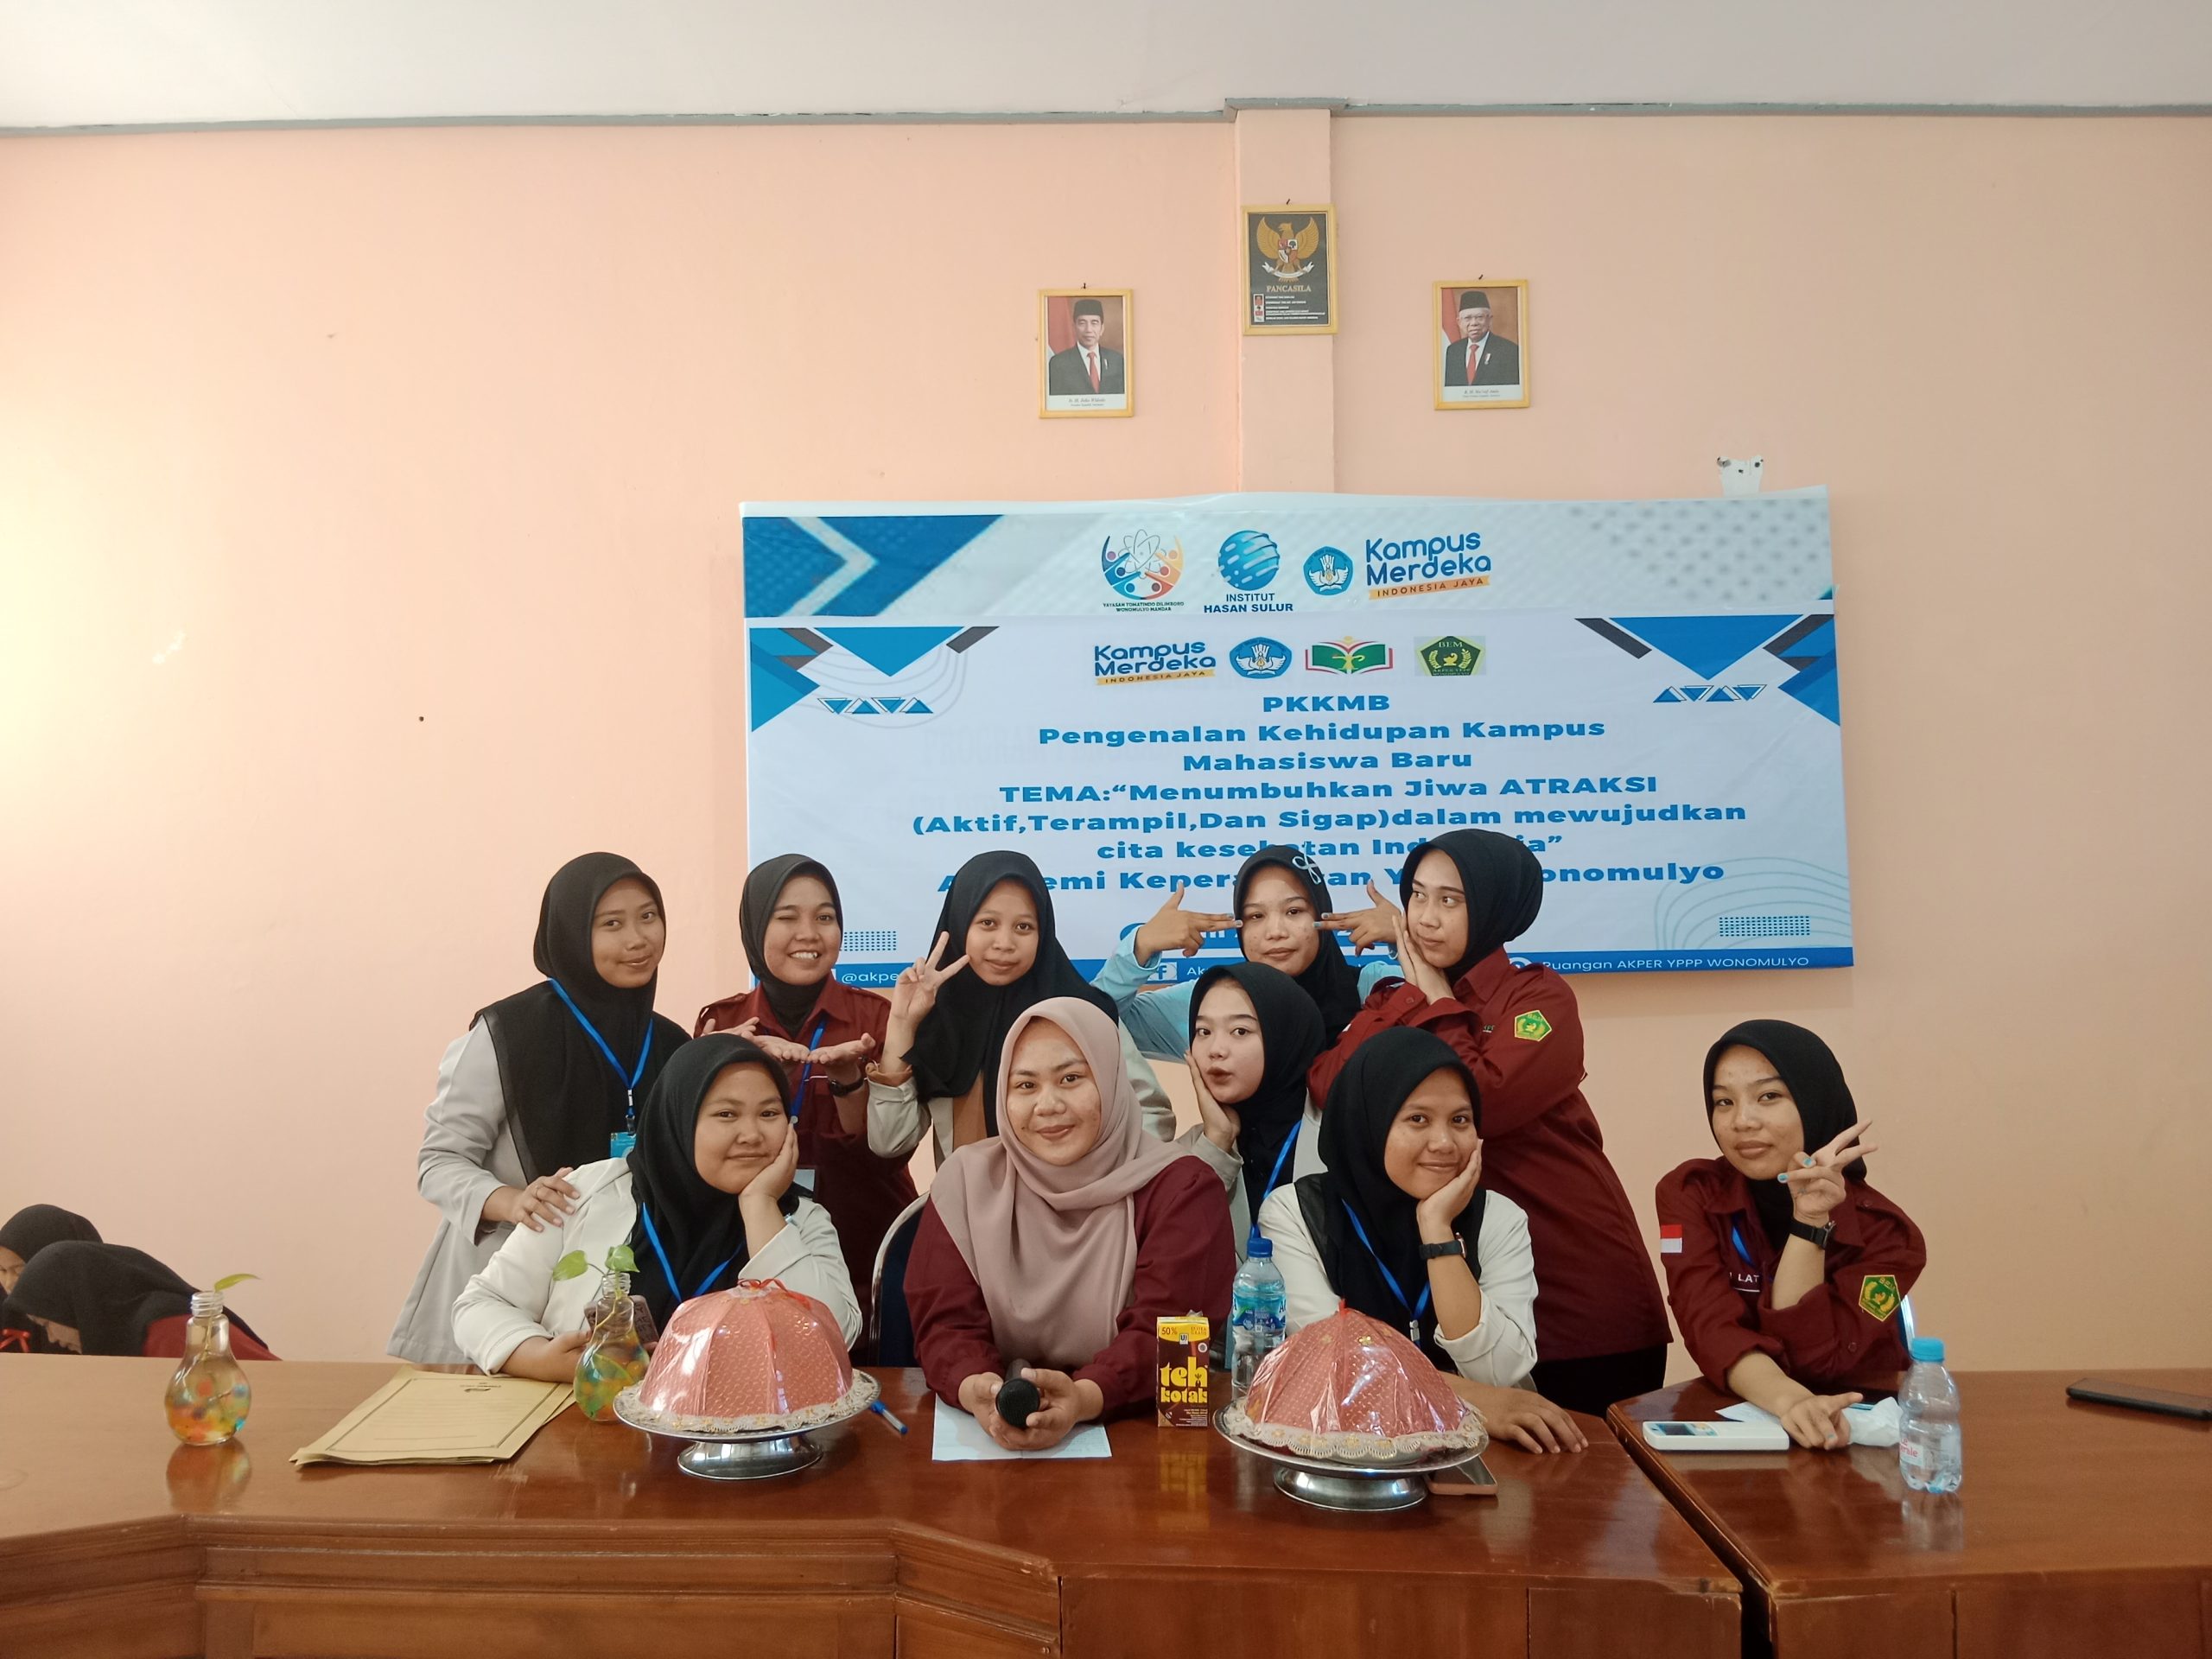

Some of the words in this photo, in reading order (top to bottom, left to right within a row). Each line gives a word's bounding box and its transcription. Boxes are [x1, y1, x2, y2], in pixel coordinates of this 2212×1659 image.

[1266, 284, 1312, 293] PANCASILA
[1365, 532, 1481, 562] Kampus
[1367, 553, 1491, 586] Merdeka
[1376, 582, 1446, 597] INDONESIA
[1453, 577, 1484, 588] JAYA
[1225, 593, 1275, 602] INSTITUT
[1204, 604, 1248, 613] HASAN
[1251, 603, 1294, 613] SULUR
[1094, 642, 1205, 662] Kampus
[1095, 655, 1217, 677] Merdeka
[1263, 695, 1390, 713] PKKMB
[1039, 725, 1246, 747] Pengenalan
[1258, 721, 1450, 744] Kehidupan
[1462, 721, 1605, 741] Kampus
[1183, 751, 1379, 772] Mahasiswa
[1391, 752, 1472, 768] Baru
[1404, 778, 1488, 797] Jiwa
[1499, 776, 1657, 795] ATRAKSI
[1514, 804, 1746, 826] mewujudkan
[1096, 841, 1163, 859] cita
[1541, 862, 1725, 886] onomulyo
[1617, 959, 1662, 969] AKPER
[1667, 958, 1703, 968] YPPP
[1707, 957, 1809, 968] WONOMULYO
[1161, 1326, 1179, 1335] 50%
[1160, 1356, 1208, 1387] teh
[1160, 1387, 1208, 1403] kotak
